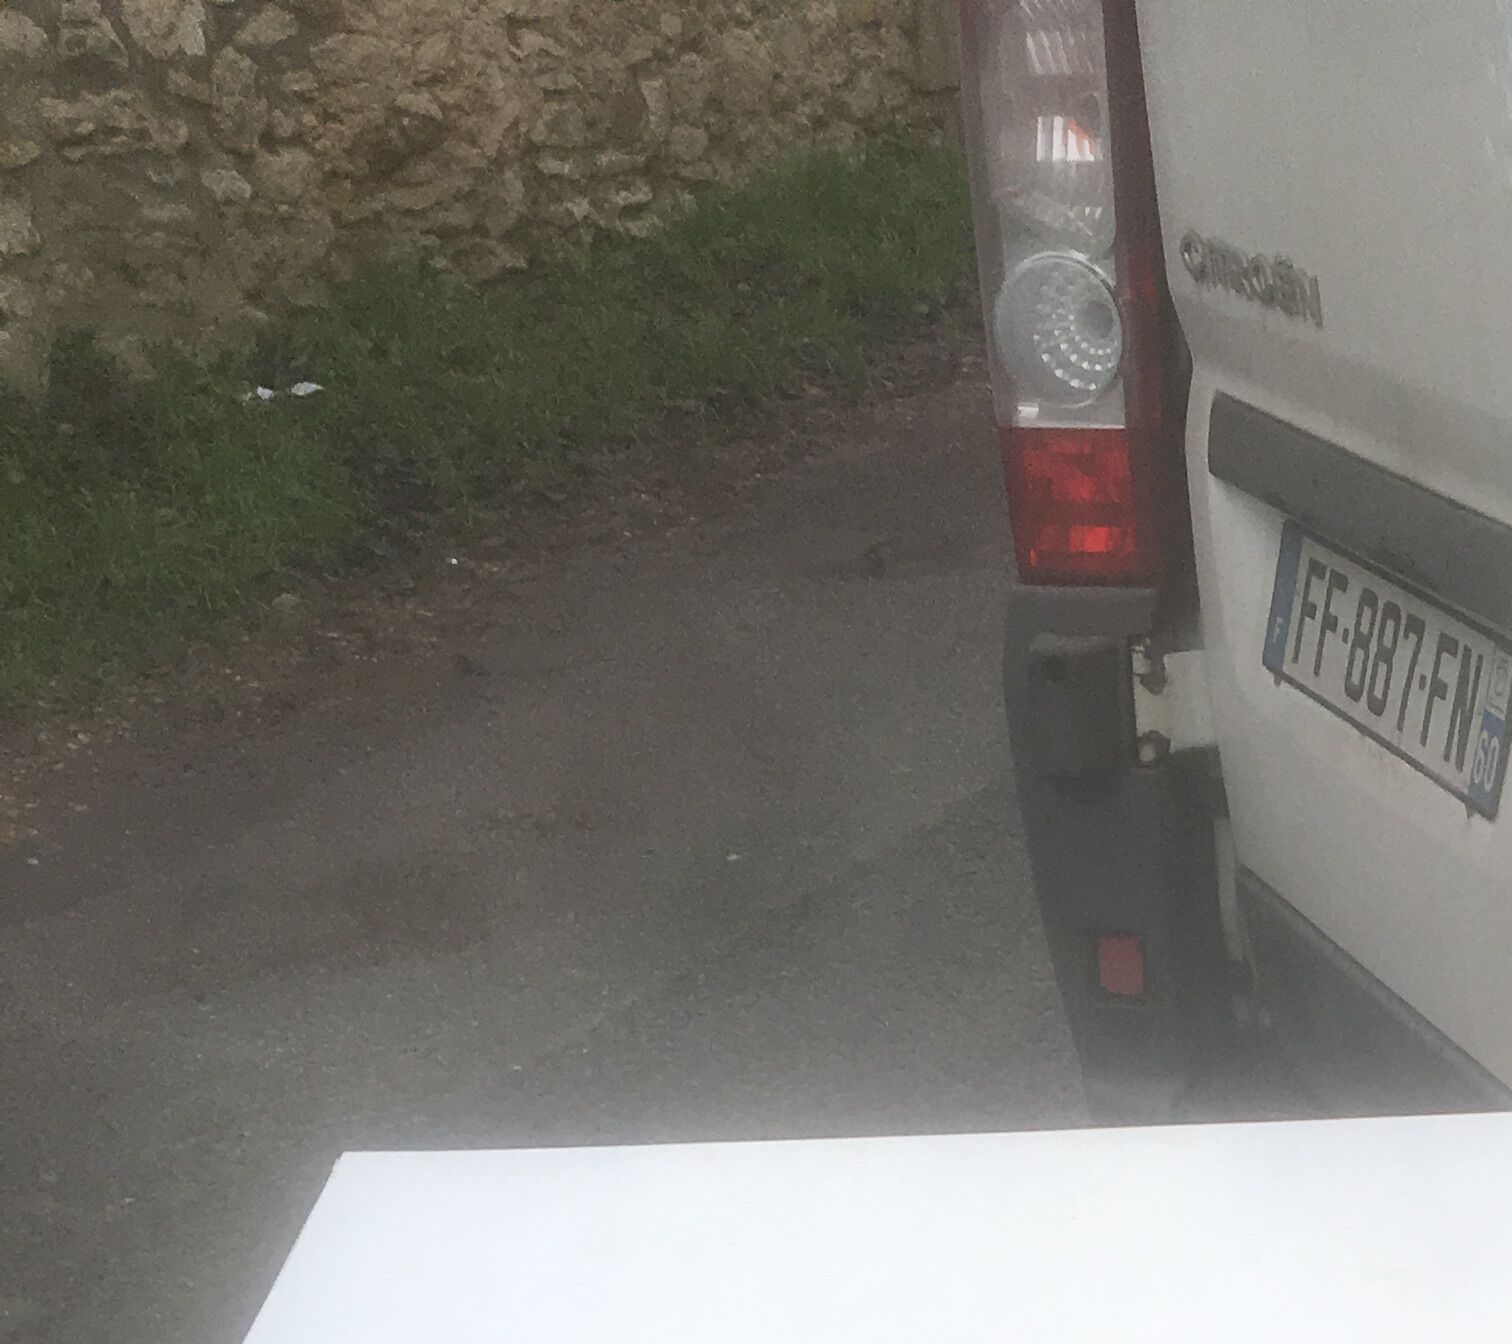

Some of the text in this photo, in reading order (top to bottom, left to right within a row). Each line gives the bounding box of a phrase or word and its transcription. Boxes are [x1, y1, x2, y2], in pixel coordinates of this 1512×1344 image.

[1272, 616, 1284, 644] F
[1292, 556, 1484, 773] FF-887-FN
[1473, 729, 1500, 791] 60
